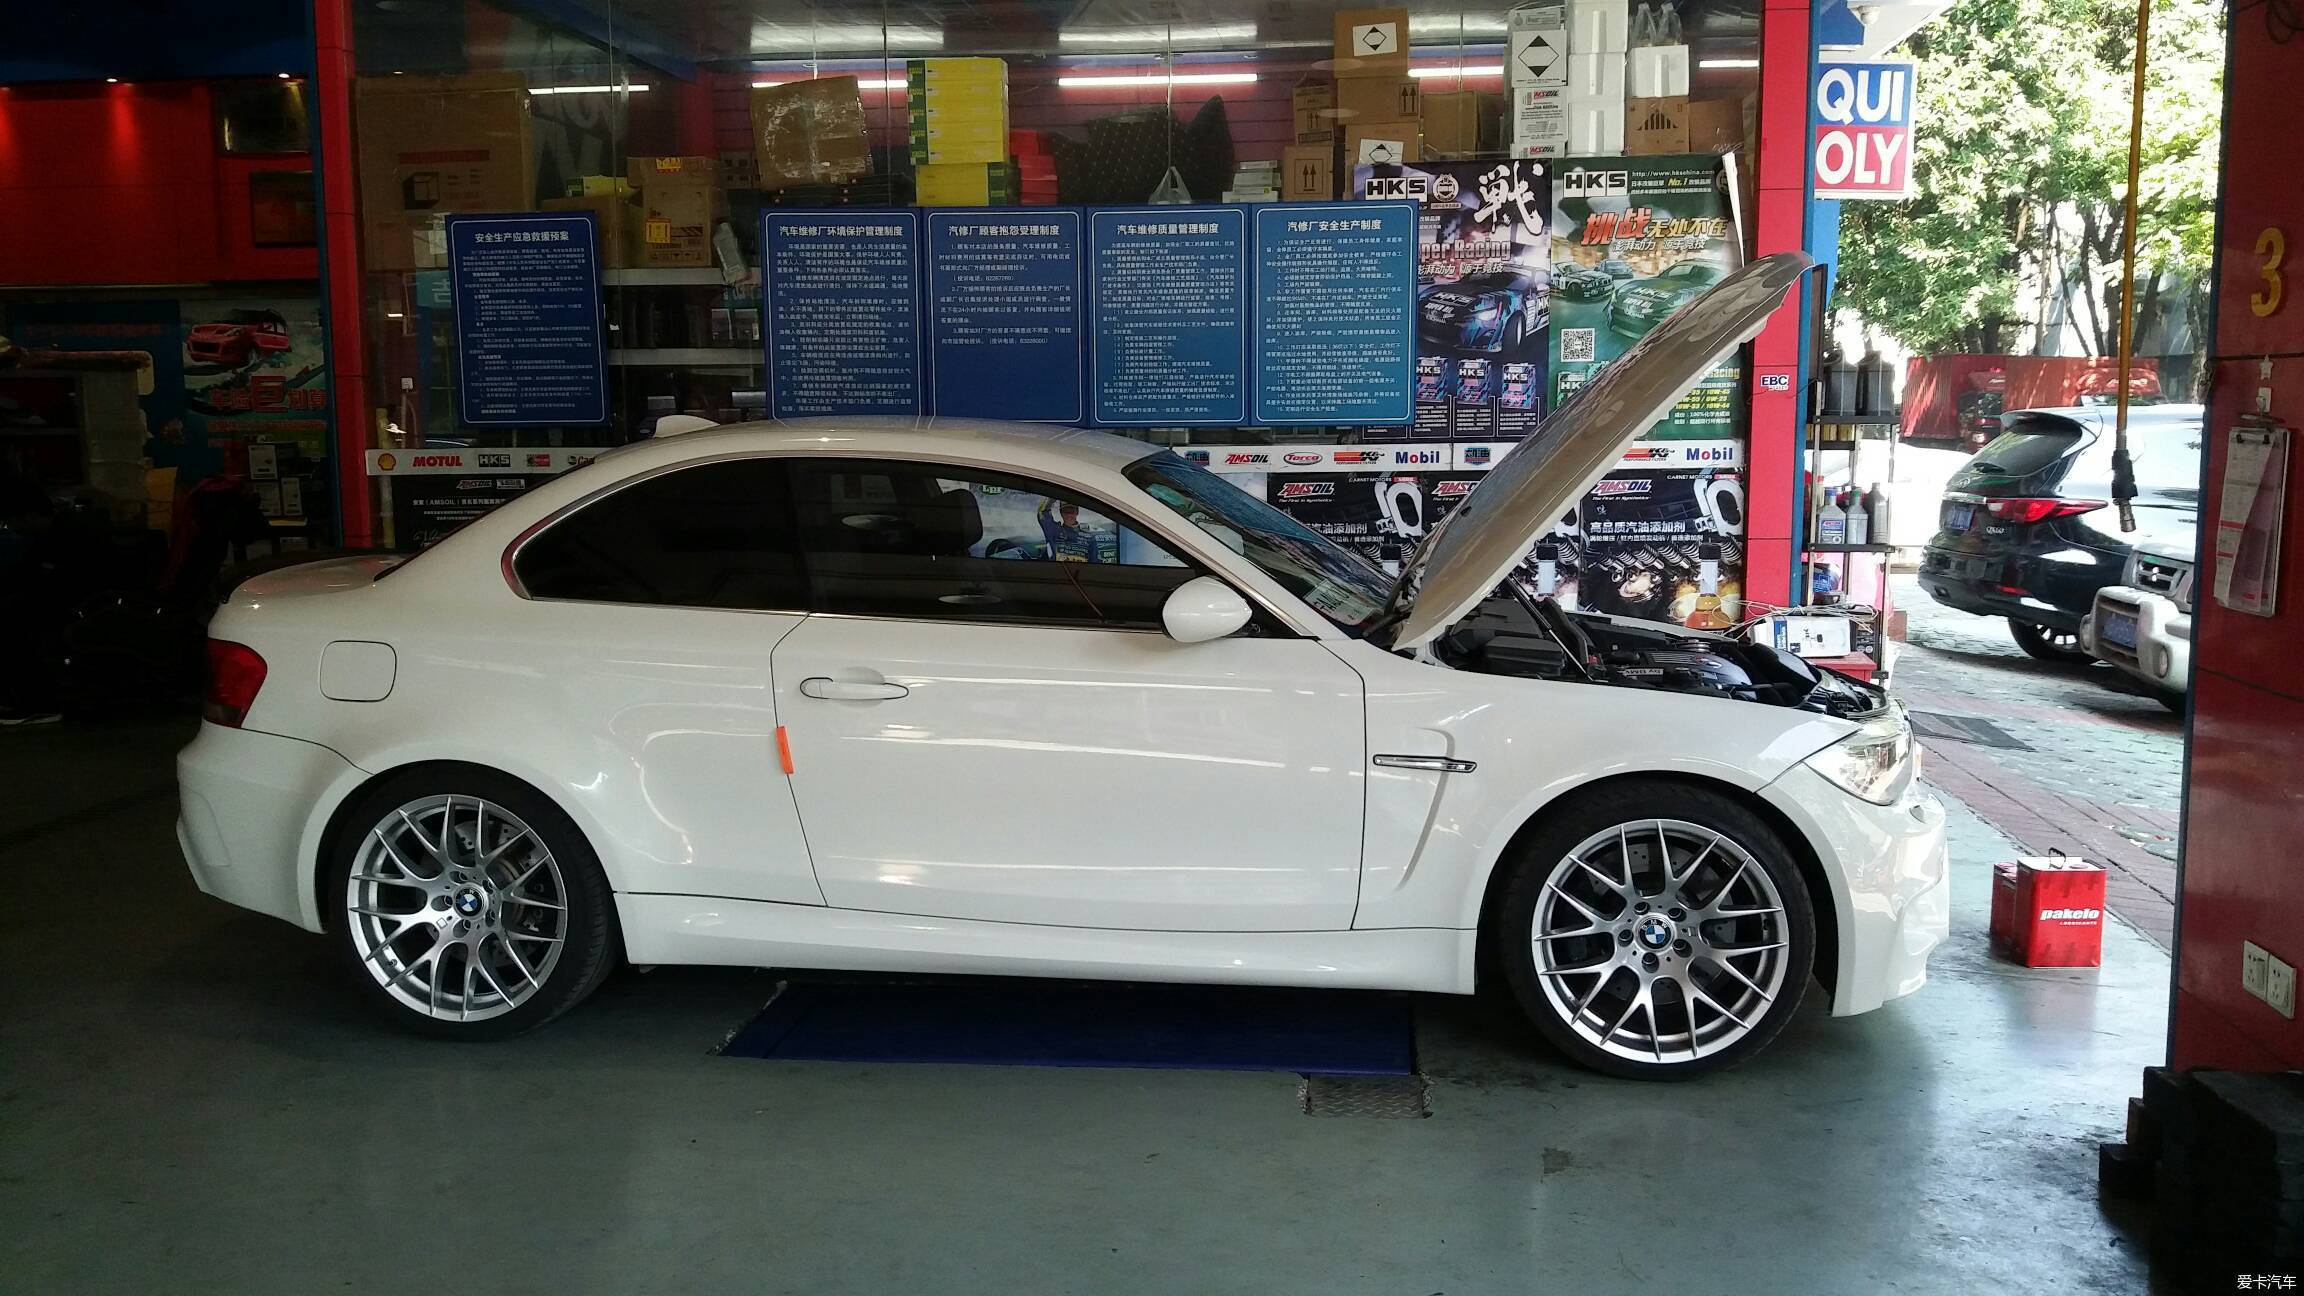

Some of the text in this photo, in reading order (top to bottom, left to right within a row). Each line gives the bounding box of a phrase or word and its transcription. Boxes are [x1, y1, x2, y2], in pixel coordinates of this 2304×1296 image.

[1817, 68, 1905, 125] QUI
[1816, 130, 1905, 185] OLY
[1366, 178, 1427, 197] HKS
[1565, 172, 1626, 190] HKS
[779, 226, 904, 237] 汽车维修厂环境保护管理制度
[948, 225, 1060, 237] 汽修厂顾客抱怨受理制度
[1117, 223, 1219, 236] 汽车维修质量管理制度
[1287, 219, 1382, 232] 汽修厂安全生产制度
[475, 231, 570, 243] 安全生产应急救援预案
[1454, 239, 1511, 261] Racing
[2250, 227, 2285, 318] 3
[1459, 368, 1485, 376] HKS
[1503, 373, 1528, 381] HKS
[1762, 376, 1787, 386] EBC
[1225, 453, 1269, 464] AMSOIL
[1288, 454, 1319, 462] Torco
[1395, 451, 1440, 464] Mobil
[1686, 447, 1733, 460] Mobil
[412, 455, 462, 467] MOTUL
[479, 454, 511, 467] HKS
[1278, 483, 1334, 497] AMSOIL
[1591, 480, 1651, 494] AMSOIL
[1590, 521, 1686, 533] 高品质汽油添加剂
[2040, 908, 2100, 921] pakelo
